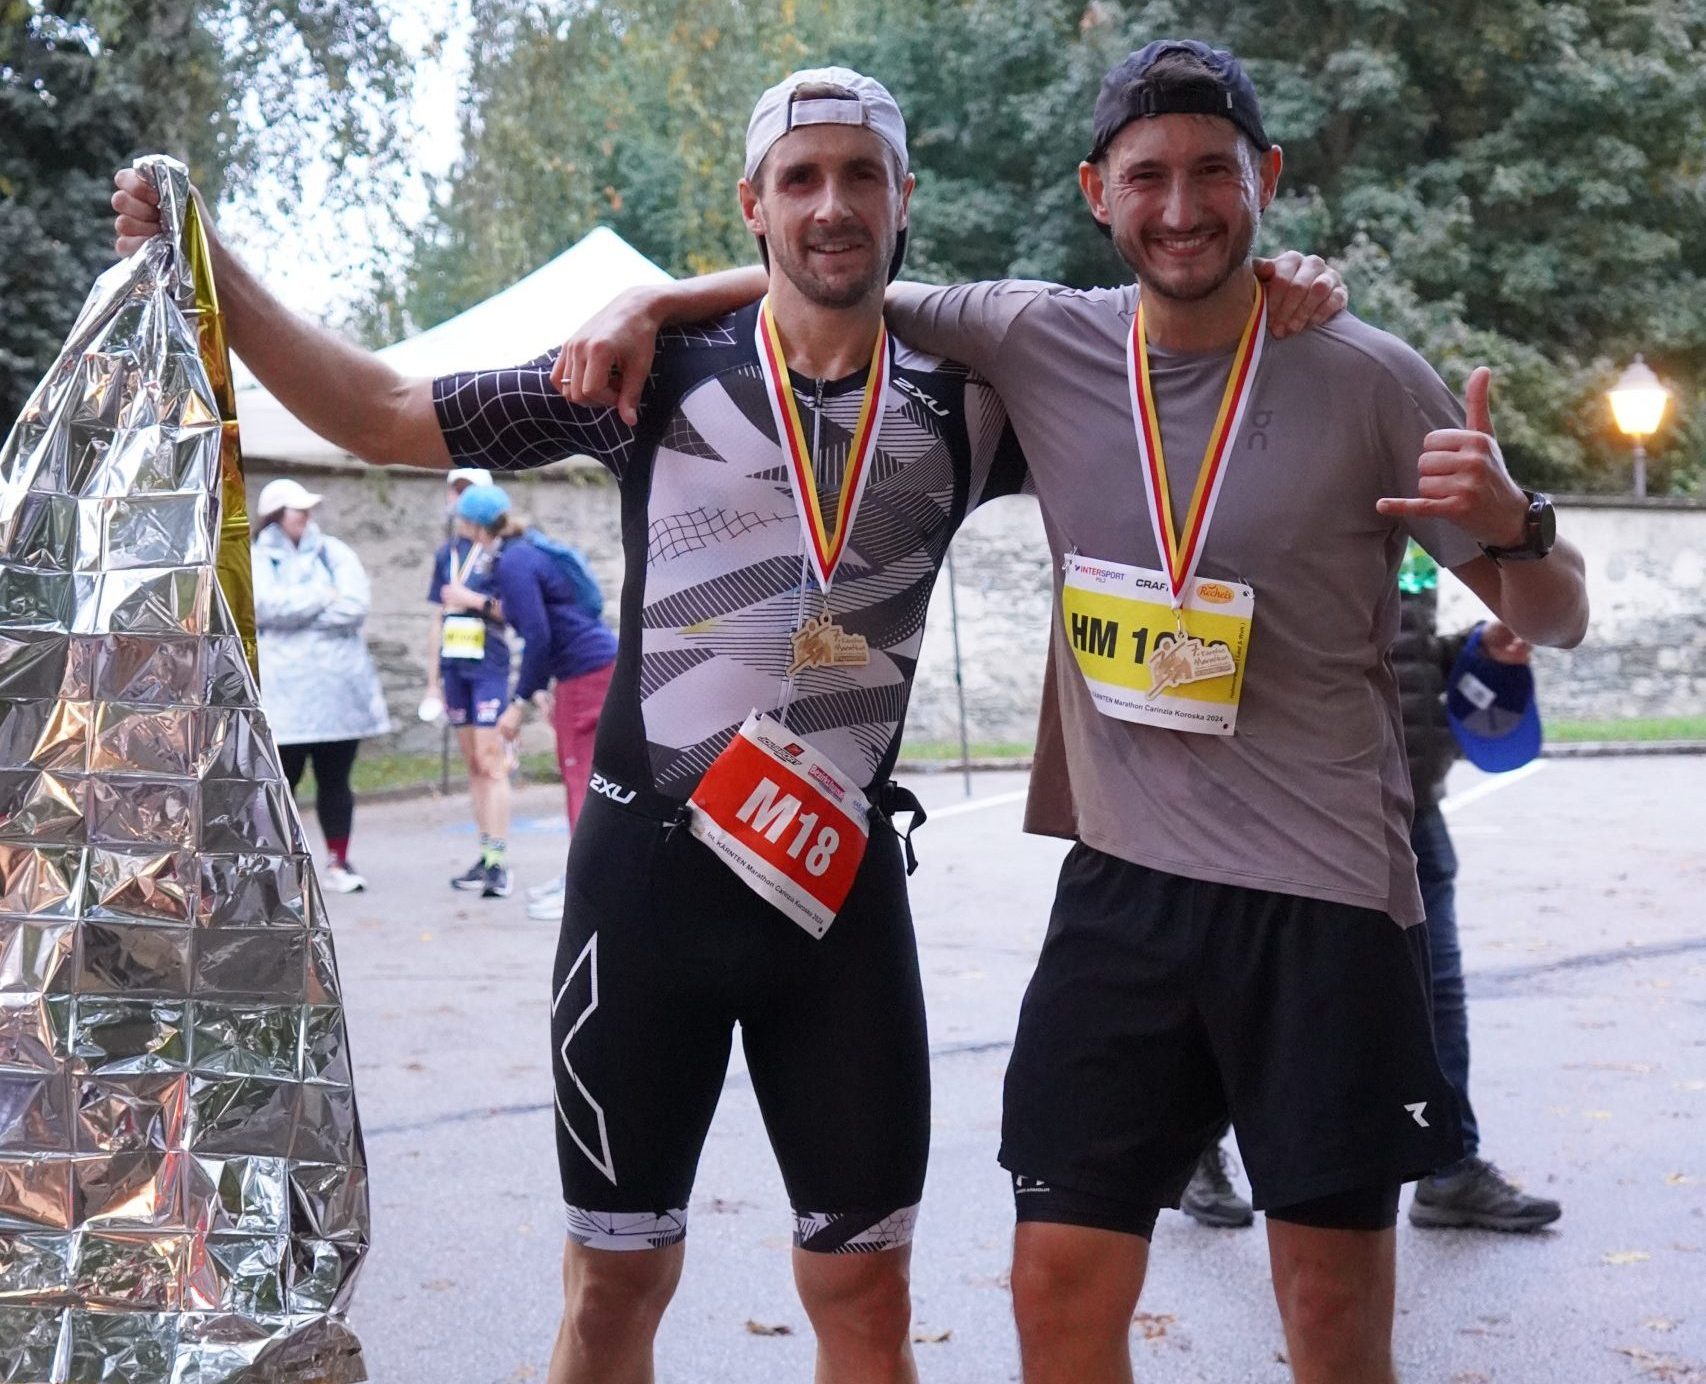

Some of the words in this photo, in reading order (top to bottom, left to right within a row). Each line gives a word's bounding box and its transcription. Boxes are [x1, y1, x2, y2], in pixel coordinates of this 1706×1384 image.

[892, 377, 950, 417] 2XU
[1080, 566, 1125, 581] INTERSPORT
[1135, 578, 1169, 592] CRAF
[1071, 613, 1119, 659] HM
[1113, 698, 1143, 711] Marathon
[1144, 704, 1173, 716] Carinzia
[1174, 709, 1205, 721] Koroska
[1206, 714, 1224, 722] 2024
[589, 772, 637, 804] 2XU
[735, 777, 840, 877] M18
[746, 864, 775, 888] Marathon
